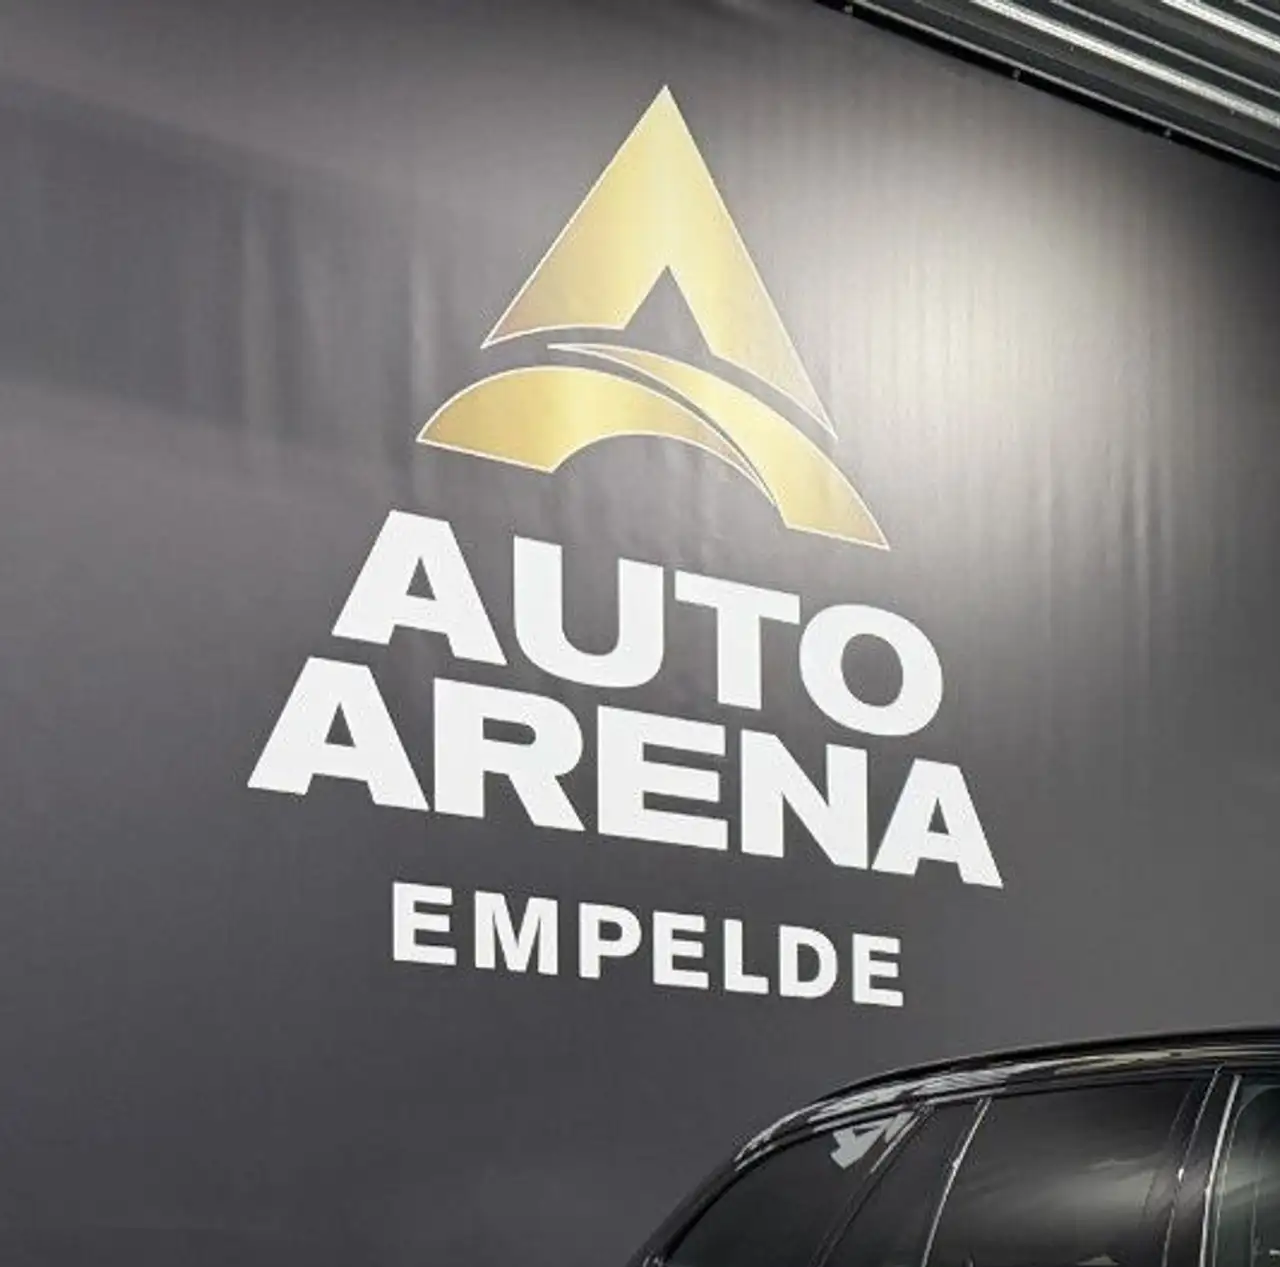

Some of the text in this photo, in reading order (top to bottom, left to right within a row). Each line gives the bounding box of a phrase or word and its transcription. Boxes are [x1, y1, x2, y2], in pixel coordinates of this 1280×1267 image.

[330, 509, 943, 736] AUTO
[247, 656, 1004, 888] ARENA
[392, 881, 904, 1007] EMPELDE
